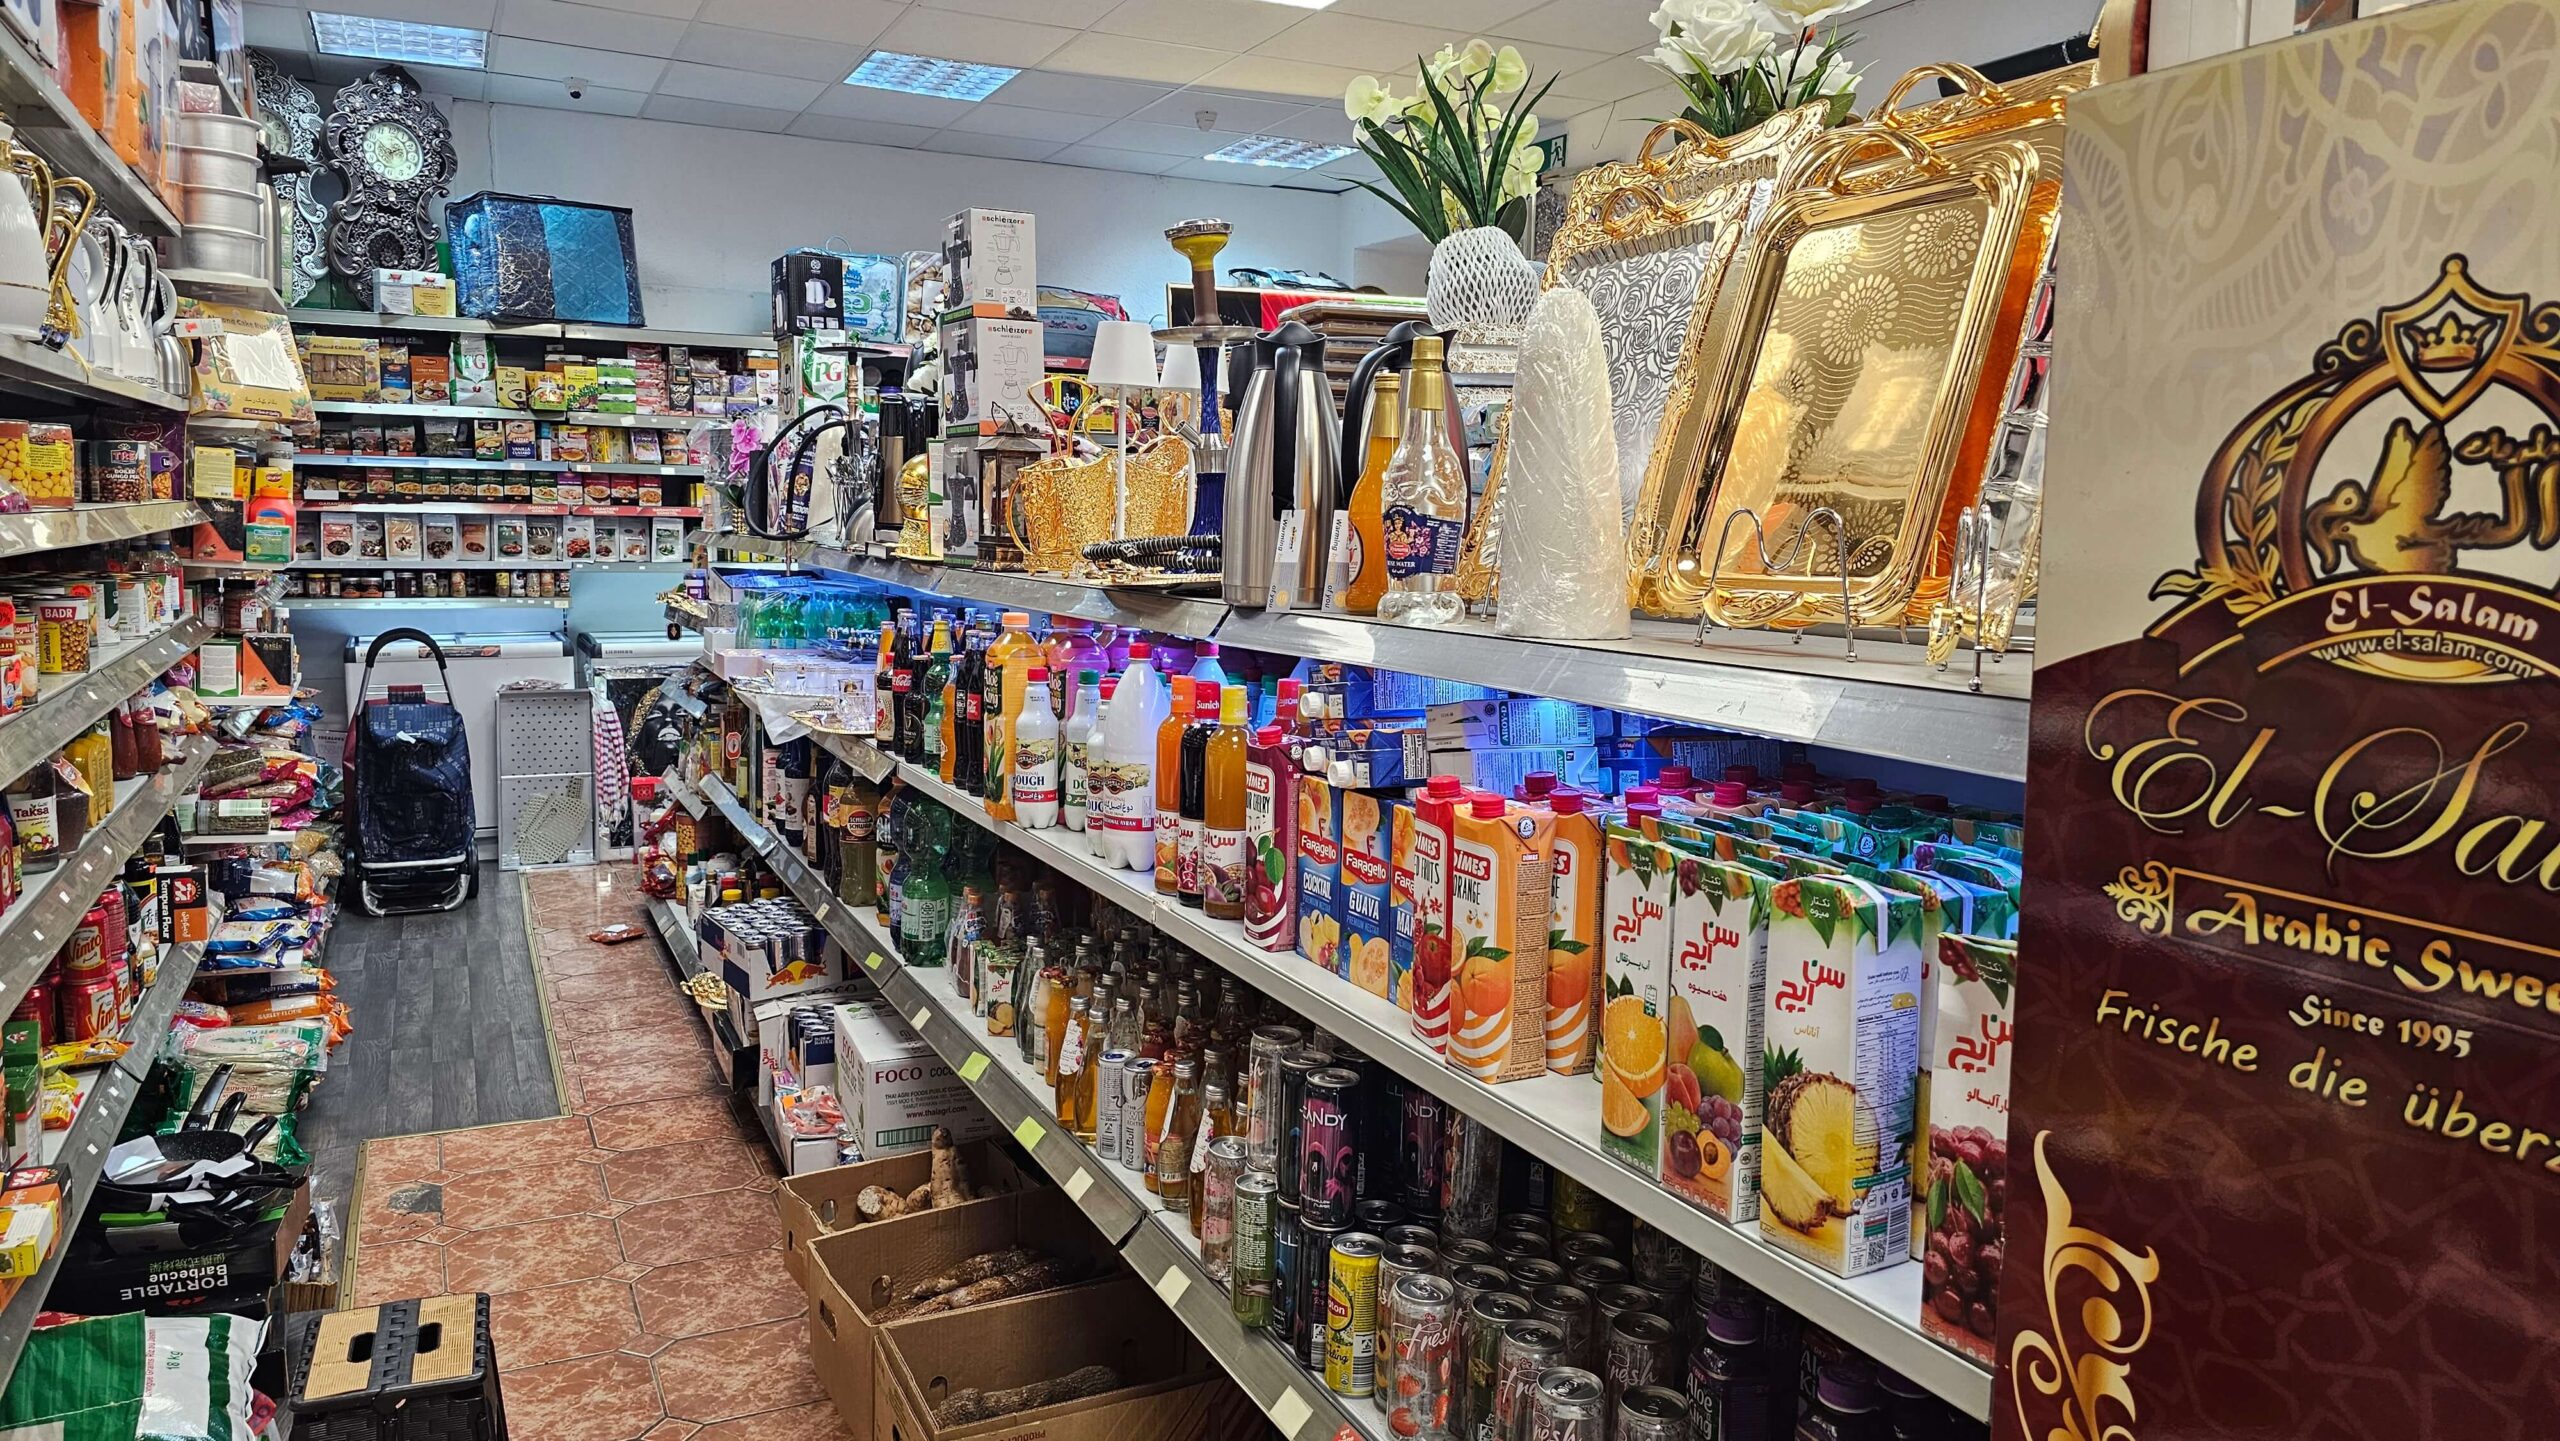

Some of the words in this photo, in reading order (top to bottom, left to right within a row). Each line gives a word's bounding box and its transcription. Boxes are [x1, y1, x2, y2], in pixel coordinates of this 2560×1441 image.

[814, 361, 843, 383] PG
[1278, 518, 1289, 552] Warming
[1331, 518, 1342, 552] Warming
[44, 608, 73, 618] BADR
[2325, 584, 2539, 642] El-Salam
[2320, 630, 2533, 679] www.el-salam.com
[1196, 700, 1220, 710] Sunich
[1500, 705, 1510, 744] AROY-D
[13, 806, 50, 819] Taksa
[1303, 871, 1332, 900] COCKTAIL
[1420, 857, 1441, 886] FRUITS
[159, 877, 171, 916] Tempura
[1349, 890, 1380, 921] GUAVA
[162, 917, 171, 940] Flour
[2188, 891, 2393, 970] Arabic
[68, 931, 103, 960] Vimto
[1793, 1025, 1821, 1039] آناناس
[2288, 993, 2385, 1037] Since
[2398, 1017, 2473, 1058] 1995
[2096, 988, 2259, 1074] Frische
[2288, 1047, 2369, 1107] die
[875, 1067, 923, 1084] FOCO
[120, 1276, 229, 1301] PORTABLE
[149, 1264, 228, 1284] Barbecue
[166, 1361, 180, 1371] 18
[167, 1350, 183, 1361] kg
[1686, 1373, 1713, 1406] Aloe
